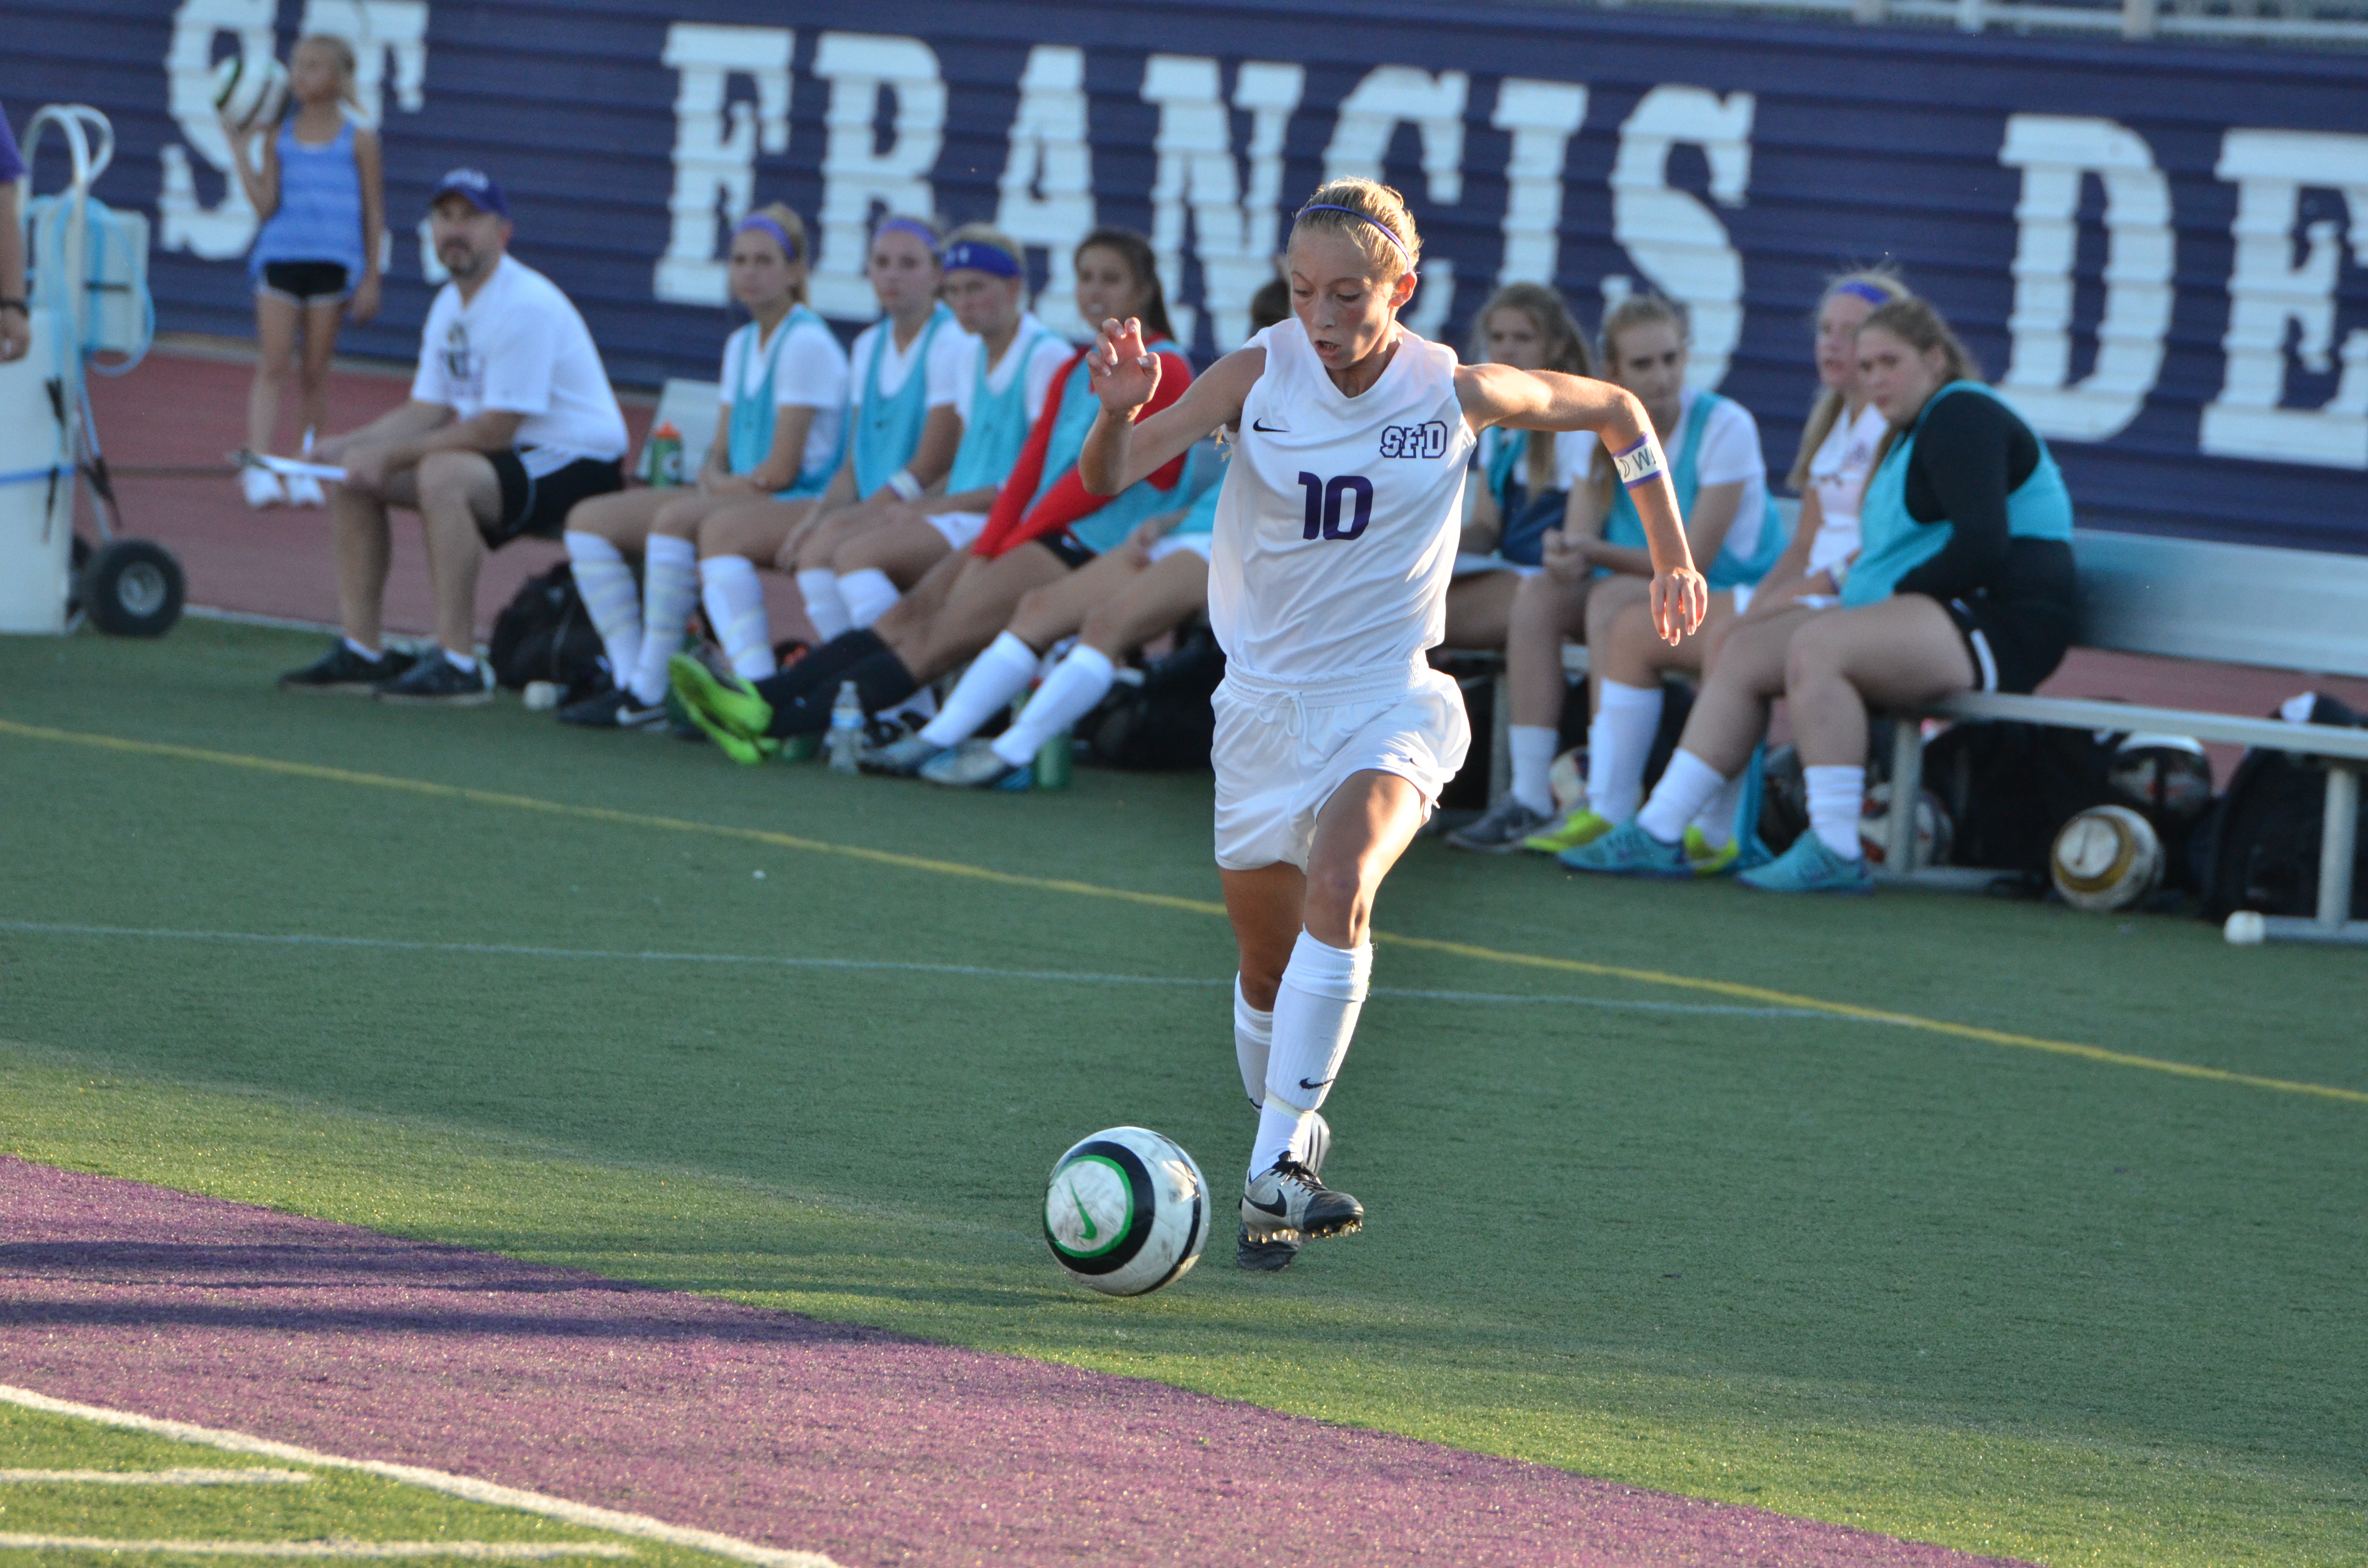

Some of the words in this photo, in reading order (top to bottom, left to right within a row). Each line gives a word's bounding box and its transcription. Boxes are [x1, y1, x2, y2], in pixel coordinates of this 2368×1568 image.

[653, 22, 1757, 392] FRANCIS
[1993, 112, 2368, 470] DE
[1380, 420, 1447, 458] SFD
[1298, 471, 1373, 540] 10
